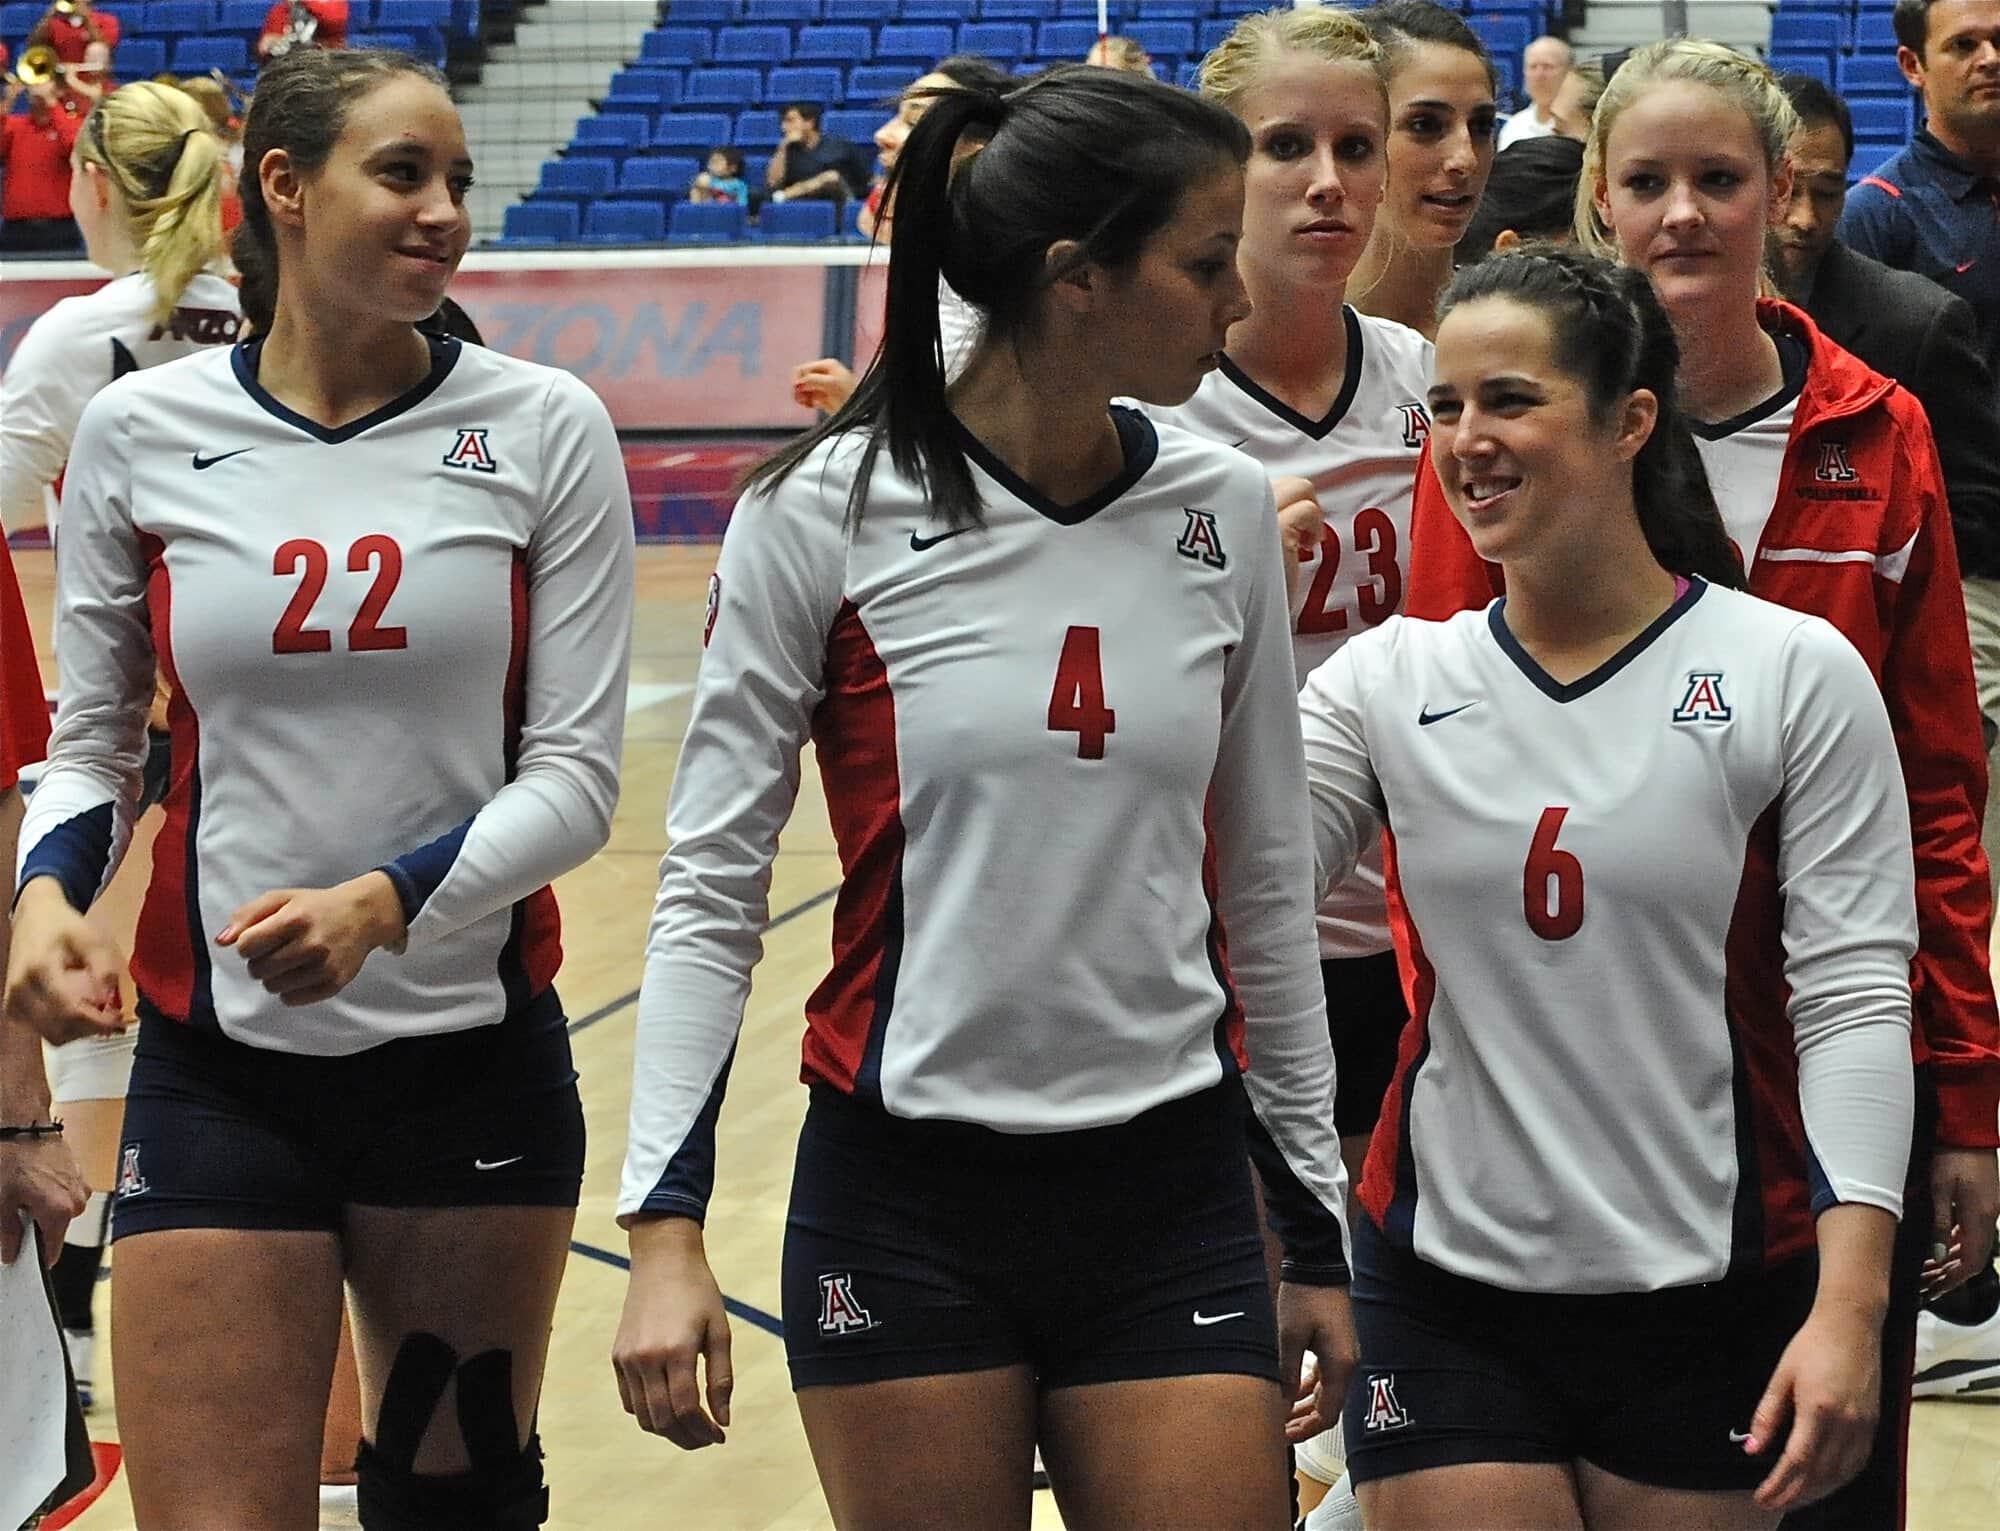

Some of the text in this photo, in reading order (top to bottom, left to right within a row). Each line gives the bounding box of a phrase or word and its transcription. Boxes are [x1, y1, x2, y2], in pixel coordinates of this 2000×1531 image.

[443, 428, 497, 474] A
[1396, 402, 1431, 448] A
[1815, 441, 1858, 482] A
[1176, 507, 1227, 571] A
[271, 532, 409, 656] 22
[1296, 507, 1402, 635] 23
[1047, 625, 1116, 760] 4
[1672, 671, 1732, 724] A
[1522, 806, 1585, 942] 6
[117, 1143, 148, 1200] A
[817, 1272, 873, 1337] A
[1364, 1373, 1409, 1433] A
